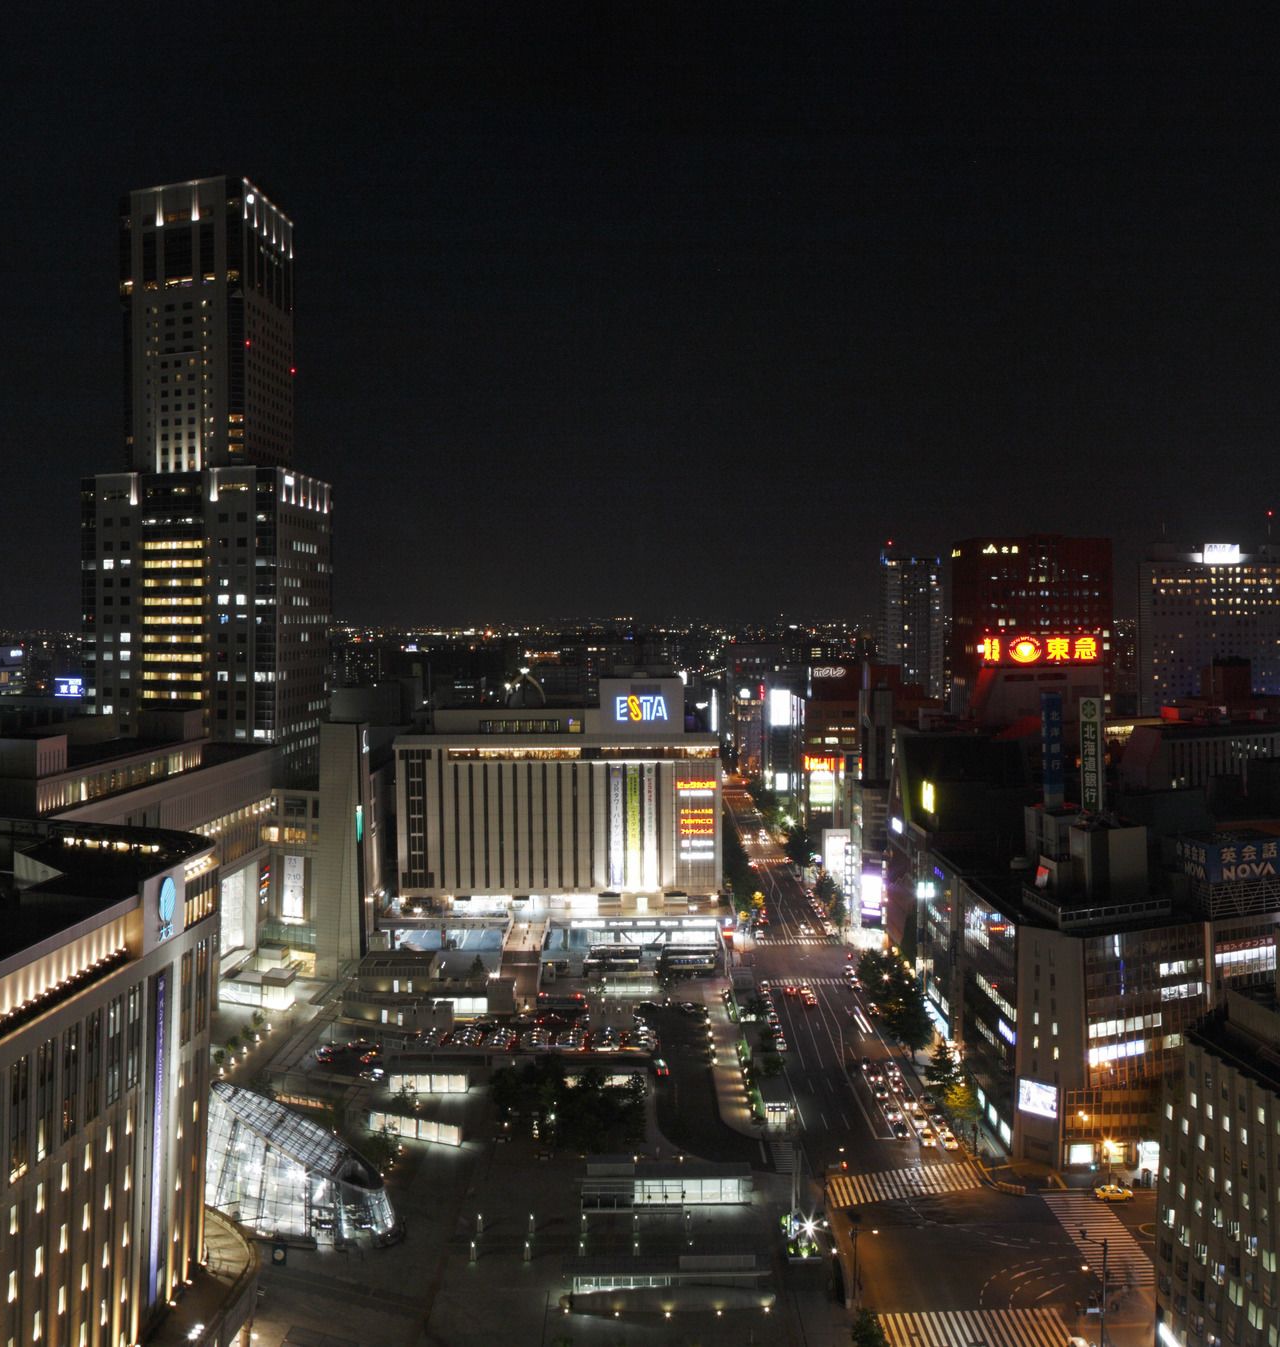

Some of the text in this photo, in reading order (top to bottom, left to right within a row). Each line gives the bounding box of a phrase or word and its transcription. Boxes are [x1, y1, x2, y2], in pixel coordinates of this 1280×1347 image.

[1046, 638, 1097, 660] 東急
[813, 667, 846, 678] ホクレン
[616, 696, 668, 721] ESTA
[1083, 723, 1097, 803] 北海道銀行
[1221, 842, 1278, 863] 英会話
[1222, 862, 1276, 880] NOVA
[724, 918, 733, 927] P
